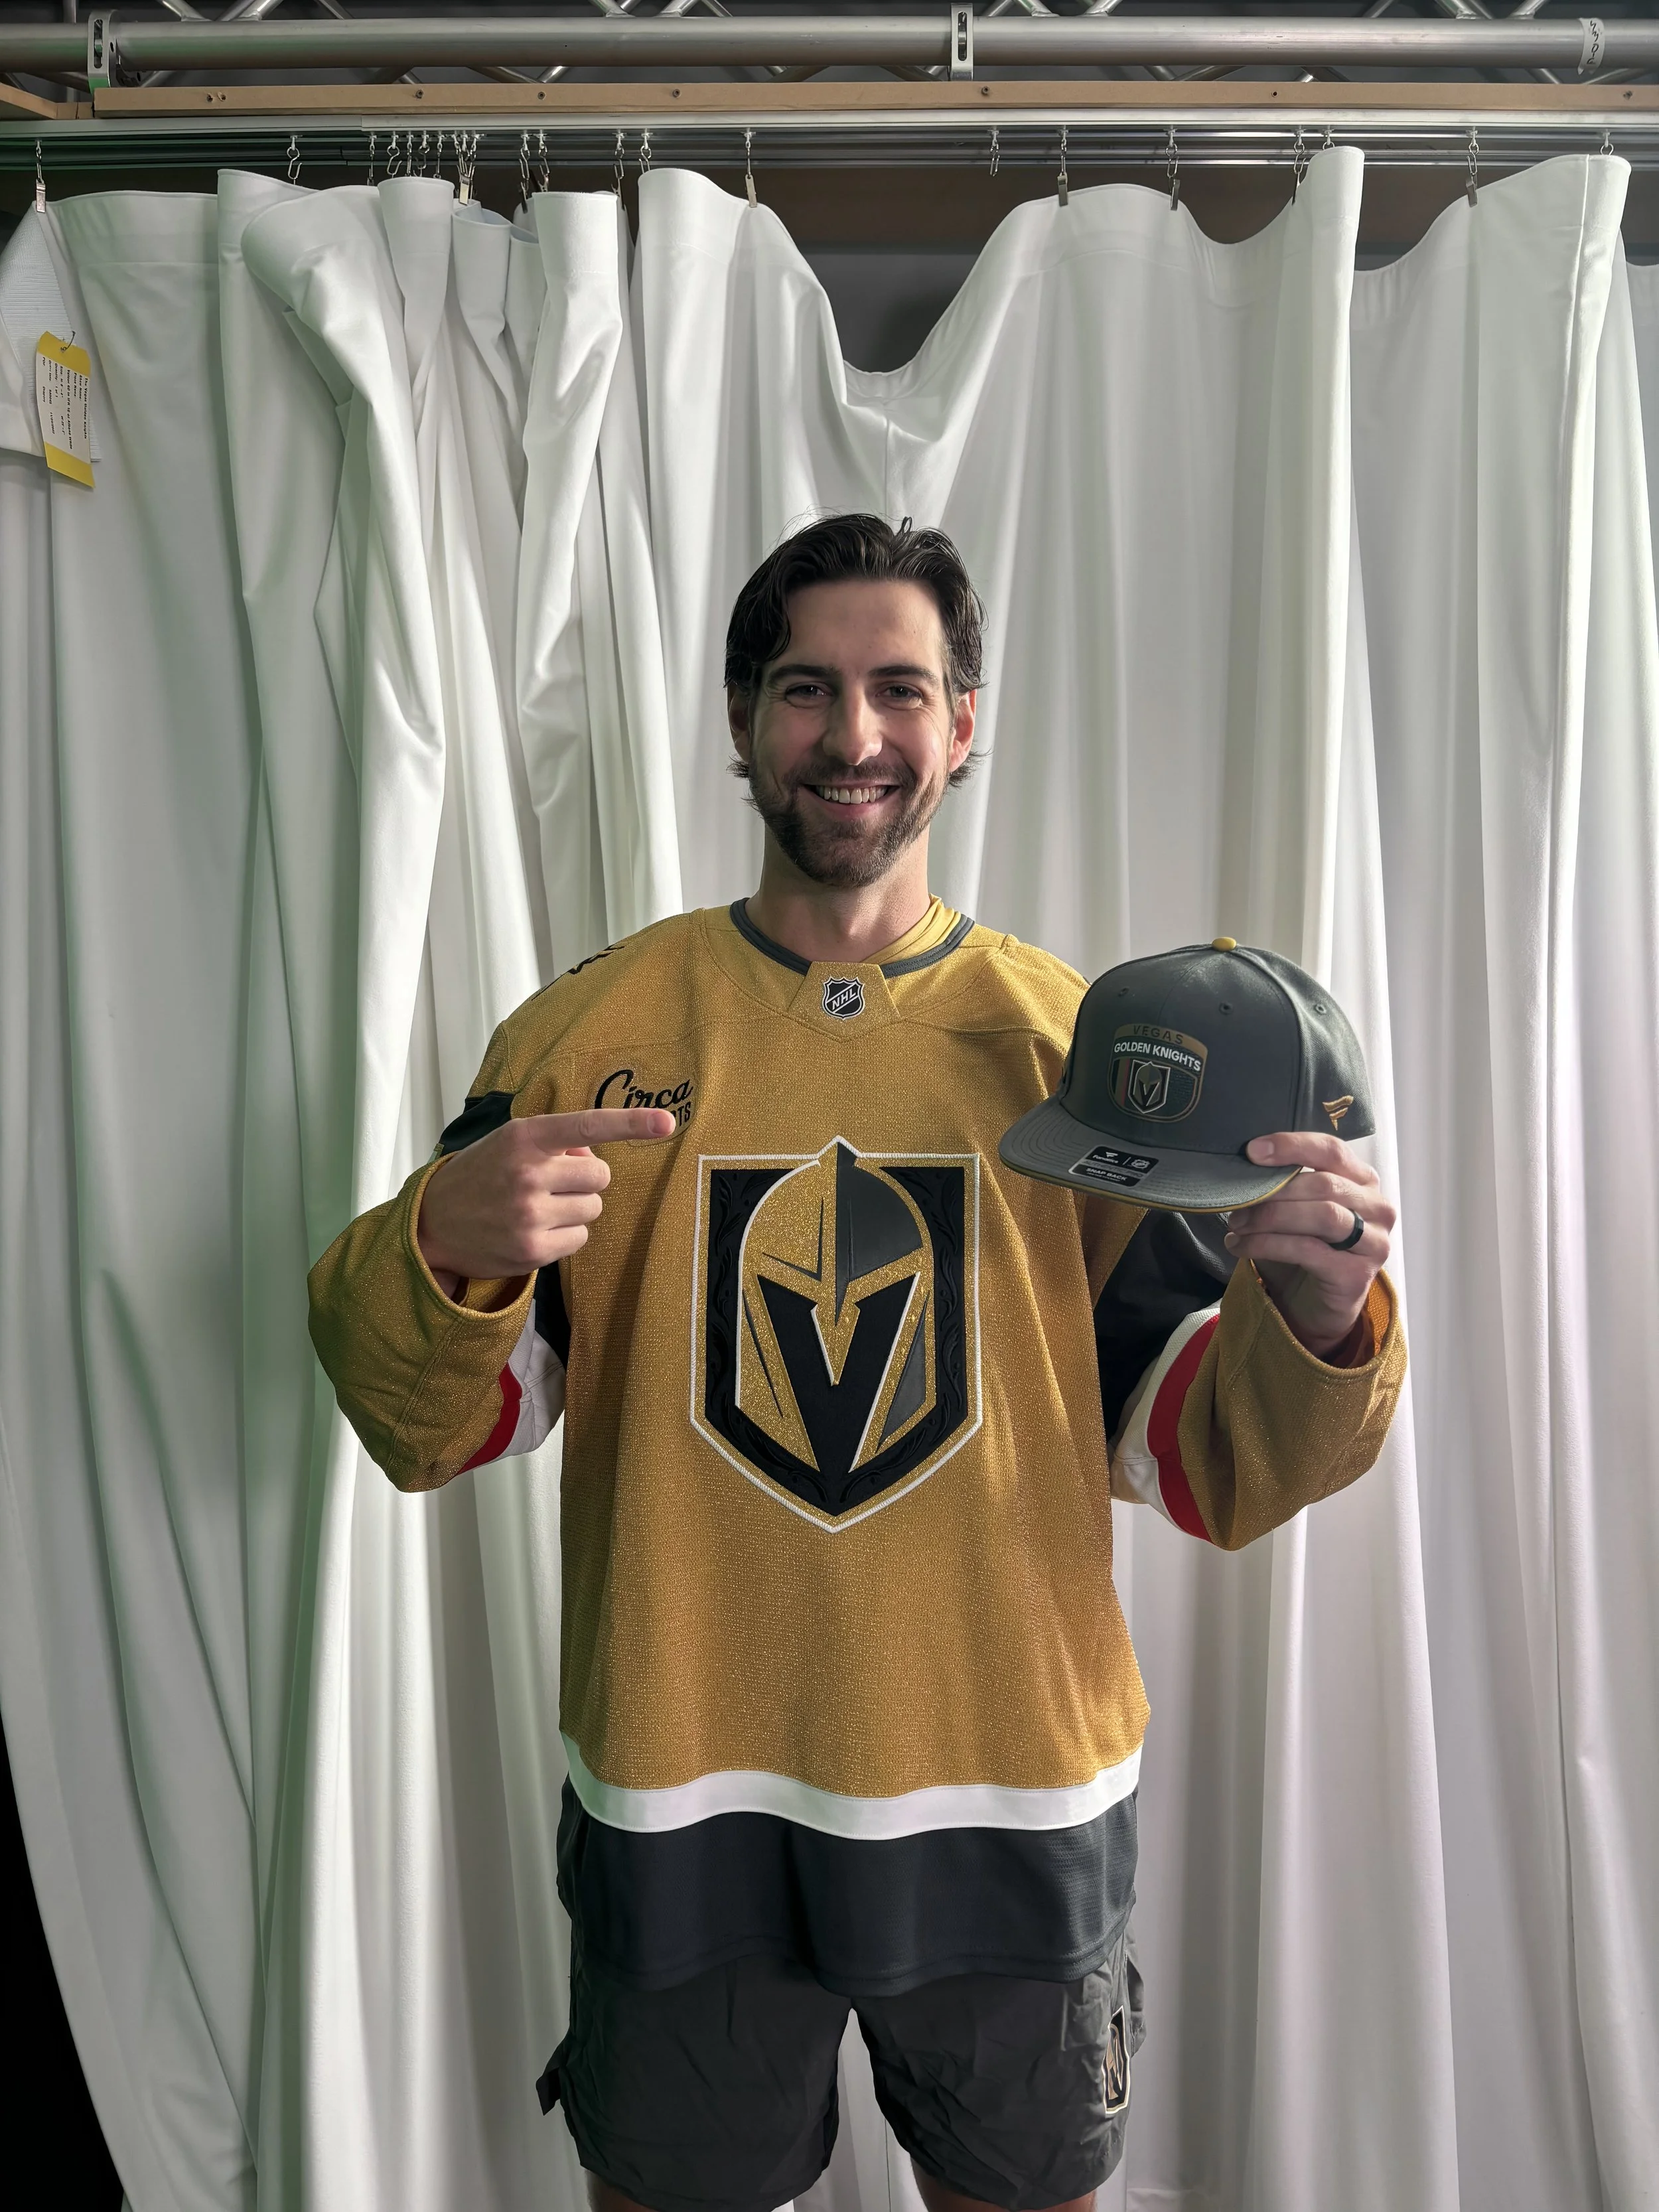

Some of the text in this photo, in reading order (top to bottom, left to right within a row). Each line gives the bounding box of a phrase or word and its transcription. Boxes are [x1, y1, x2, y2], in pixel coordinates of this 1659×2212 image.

[831, 988, 857, 1010] NHL
[1133, 1025, 1184, 1045] VEGAS
[1114, 1041, 1202, 1071] GOLDEN KNIGHTS
[594, 1069, 693, 1109] Circa
[1106, 1172, 1128, 1181] BACK
